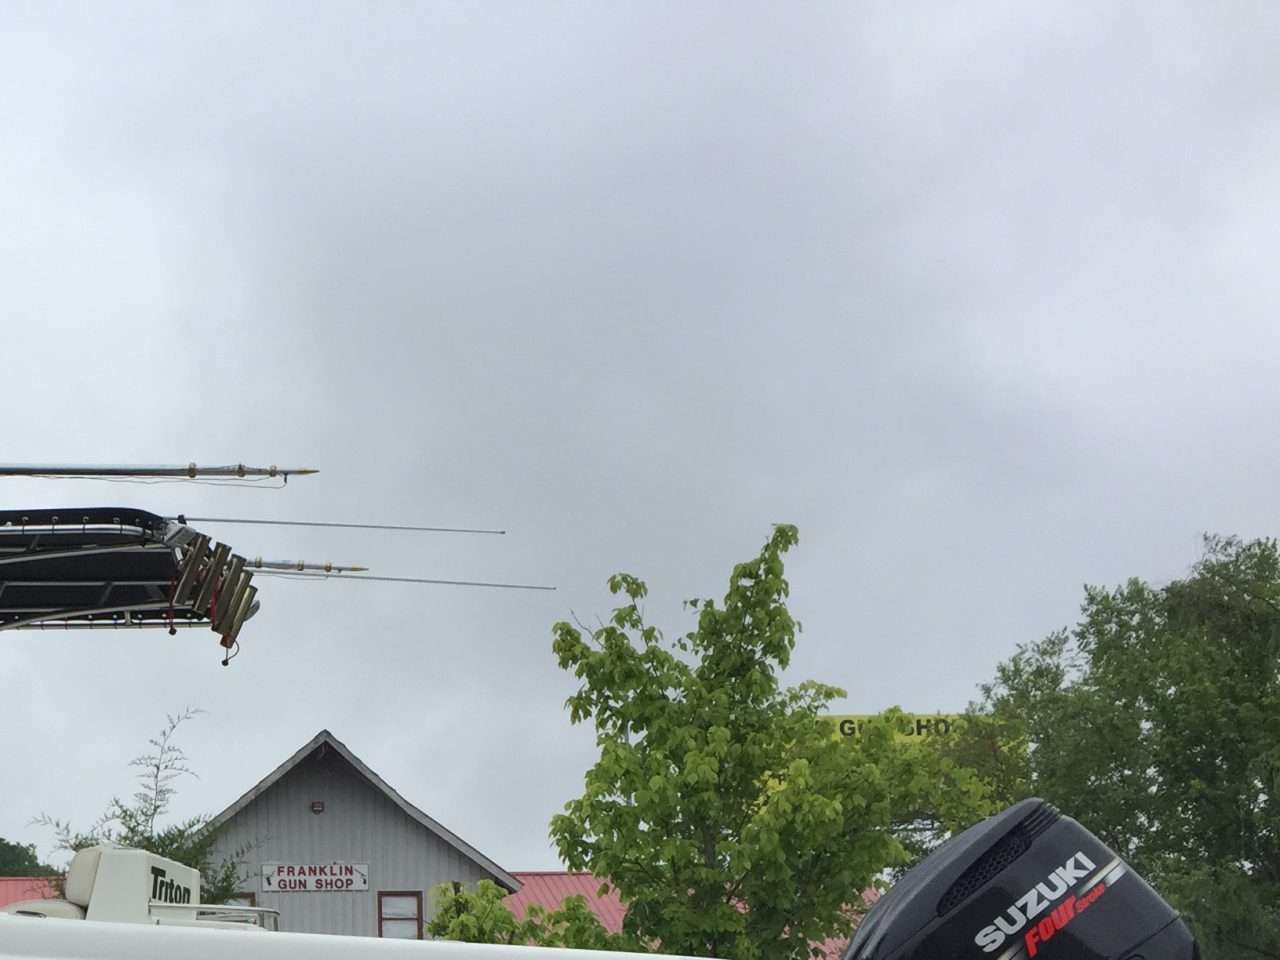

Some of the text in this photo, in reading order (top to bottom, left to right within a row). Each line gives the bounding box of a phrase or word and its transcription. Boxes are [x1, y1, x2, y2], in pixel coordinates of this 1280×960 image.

[277, 866, 354, 877] FRANKLIN
[151, 866, 191, 904] Triton
[278, 879, 354, 890] GUN SHOP
[974, 851, 1097, 953] SUZUKI
